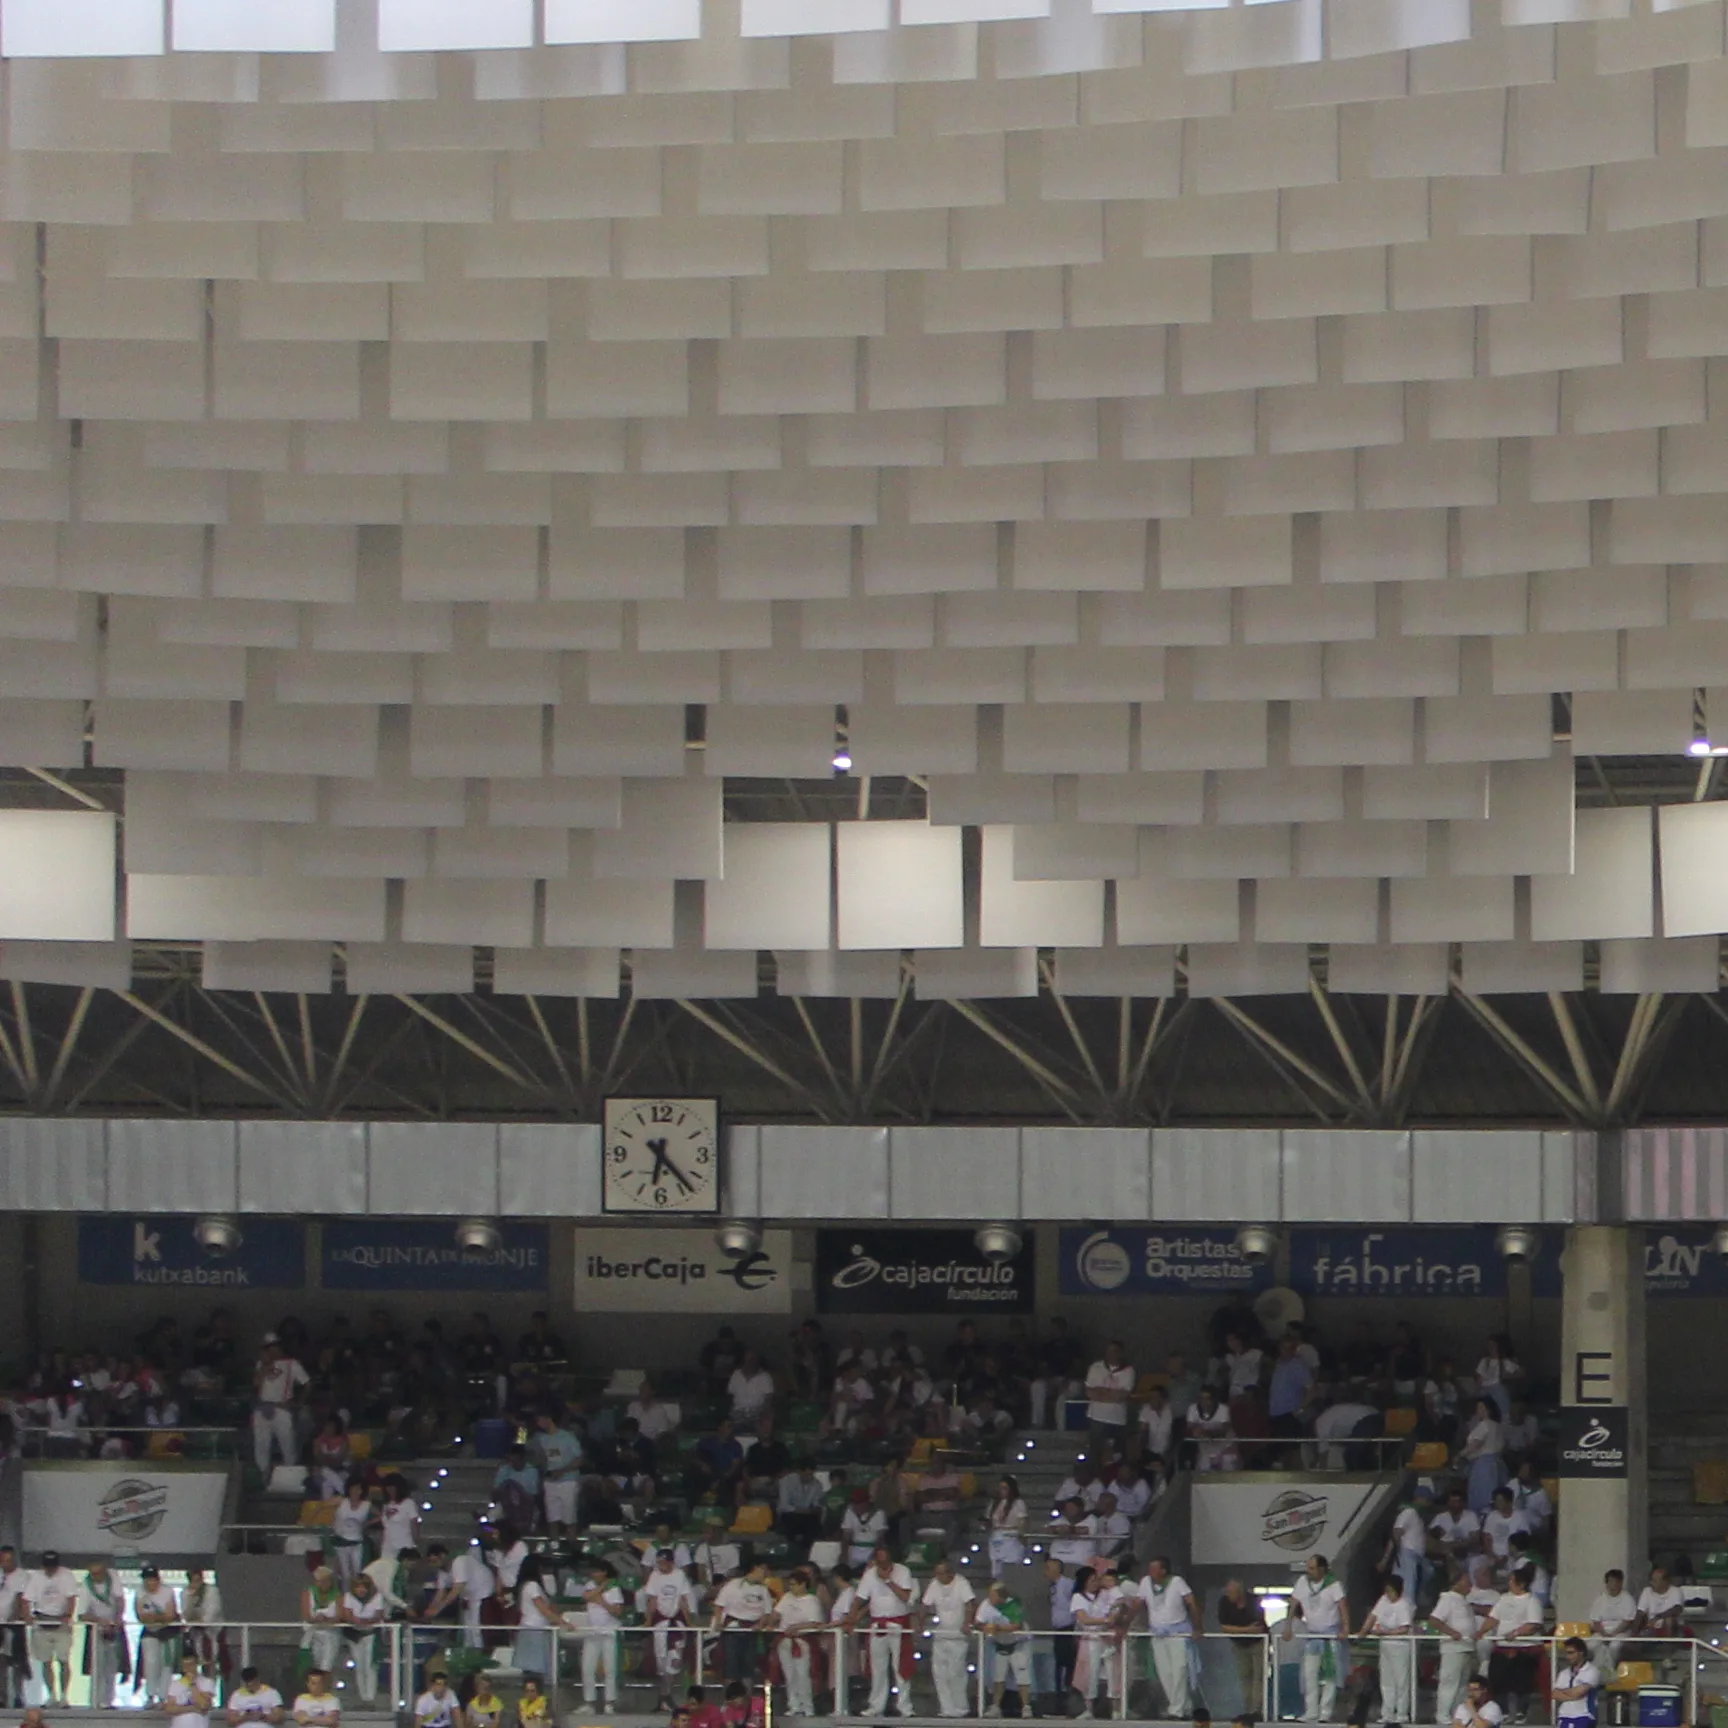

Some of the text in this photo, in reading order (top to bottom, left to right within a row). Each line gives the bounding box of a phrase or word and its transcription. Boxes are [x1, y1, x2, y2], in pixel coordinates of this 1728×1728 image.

[651, 1106, 673, 1123] 12
[614, 1146, 627, 1163] 9
[697, 1147, 709, 1164] 3
[655, 1188, 668, 1205] 6
[350, 1245, 440, 1268] QUINTA
[459, 1249, 540, 1268] MONJE
[133, 1266, 249, 1285] kutxabank
[587, 1256, 706, 1286] iberCaja
[881, 1259, 1016, 1290] cajacírculo
[1145, 1259, 1255, 1283] Orquestas
[1312, 1255, 1482, 1285] fábrica
[1577, 1352, 1611, 1403] E
